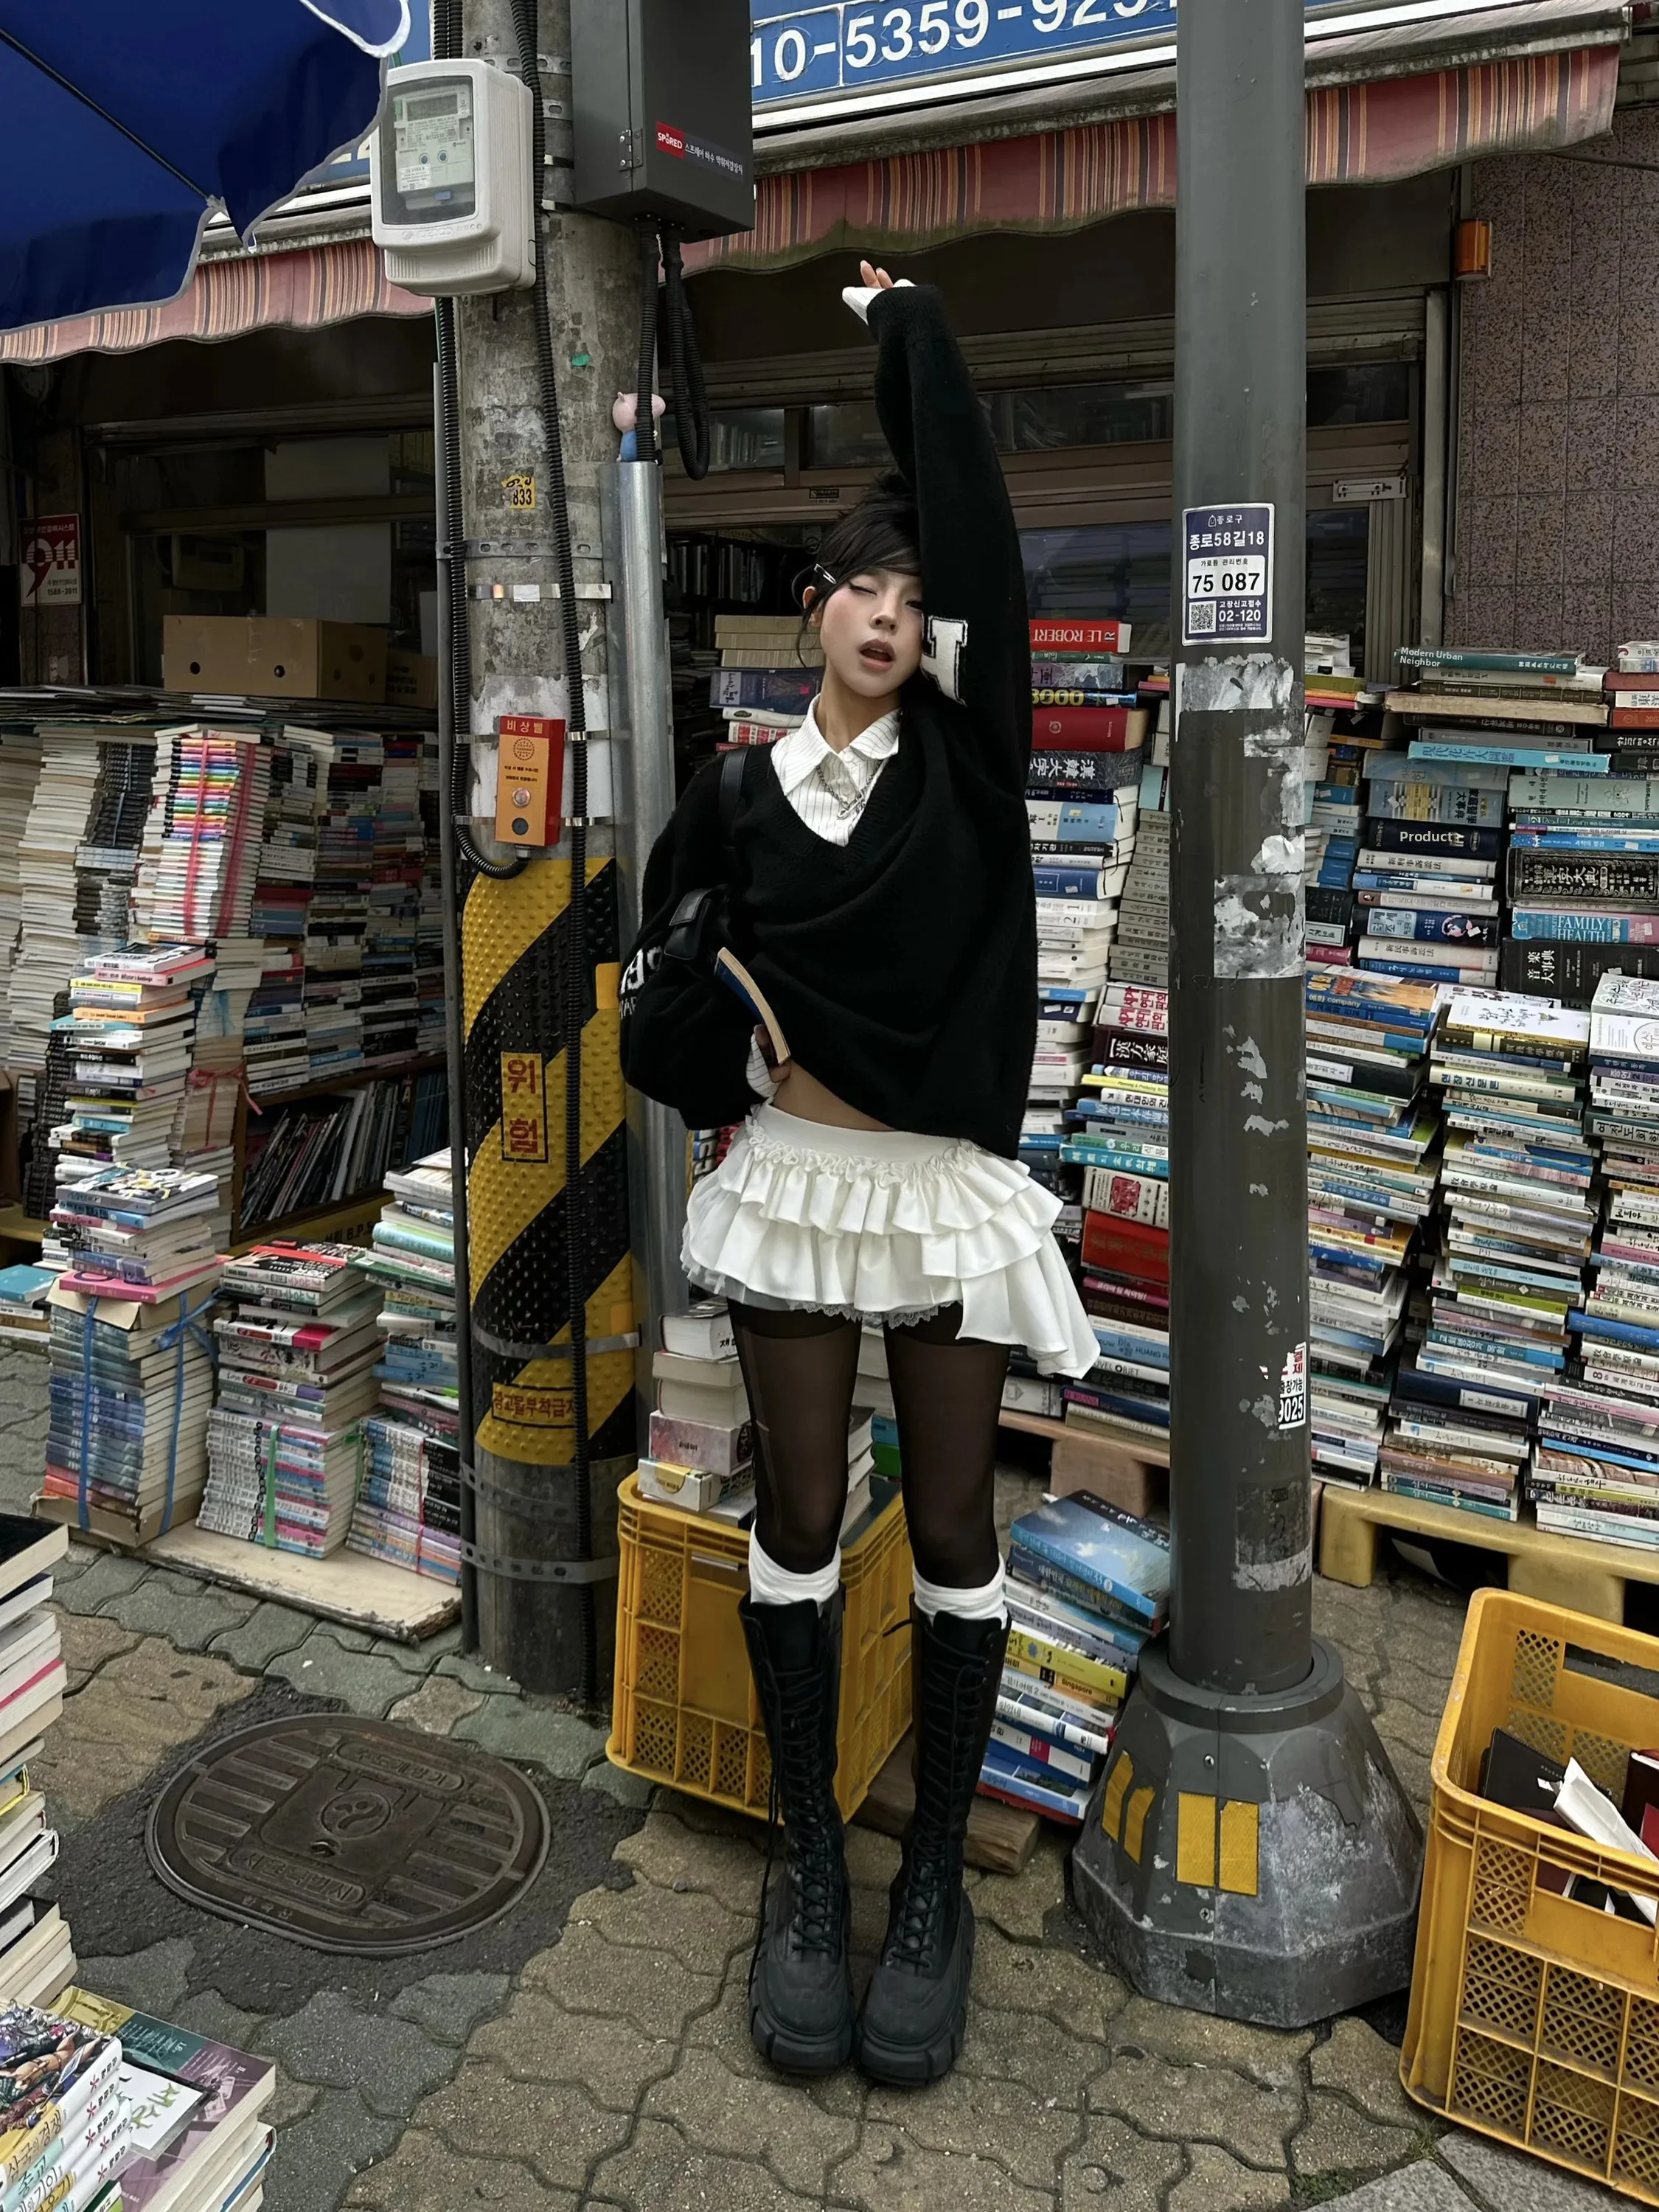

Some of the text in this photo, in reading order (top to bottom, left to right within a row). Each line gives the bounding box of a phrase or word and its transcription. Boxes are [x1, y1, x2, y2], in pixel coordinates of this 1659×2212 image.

[513, 489, 532, 506] 833
[1217, 515, 1243, 525] 종로구
[1192, 572, 1260, 594] 75 087
[1219, 609, 1261, 622] 02-120
[1033, 628, 1084, 642] ROBERT
[1087, 629, 1102, 642] LE
[1029, 756, 1096, 781] 漢韓大字
[1557, 915, 1607, 931] FAMILY
[1557, 929, 1605, 942] HEALTH
[507, 1059, 539, 1155] 위험
